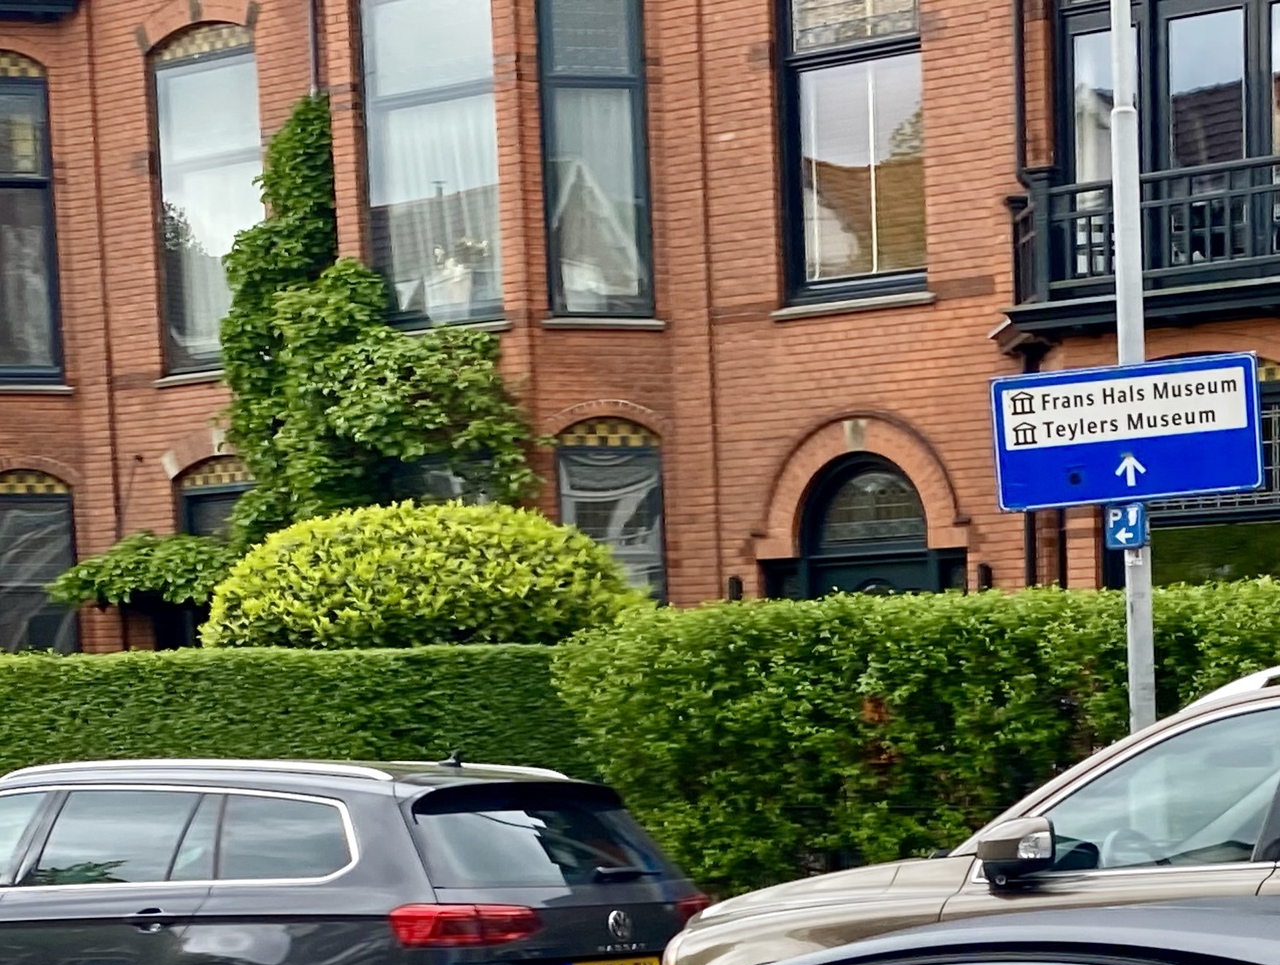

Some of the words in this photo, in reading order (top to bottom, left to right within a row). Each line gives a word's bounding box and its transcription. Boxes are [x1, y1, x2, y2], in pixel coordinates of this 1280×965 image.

[1041, 391, 1095, 411] Frans
[1102, 384, 1145, 405] Hals
[1153, 377, 1238, 400] Museum
[1043, 417, 1118, 441] Teylers
[1127, 408, 1216, 431] Museum
[1109, 508, 1123, 528] P
